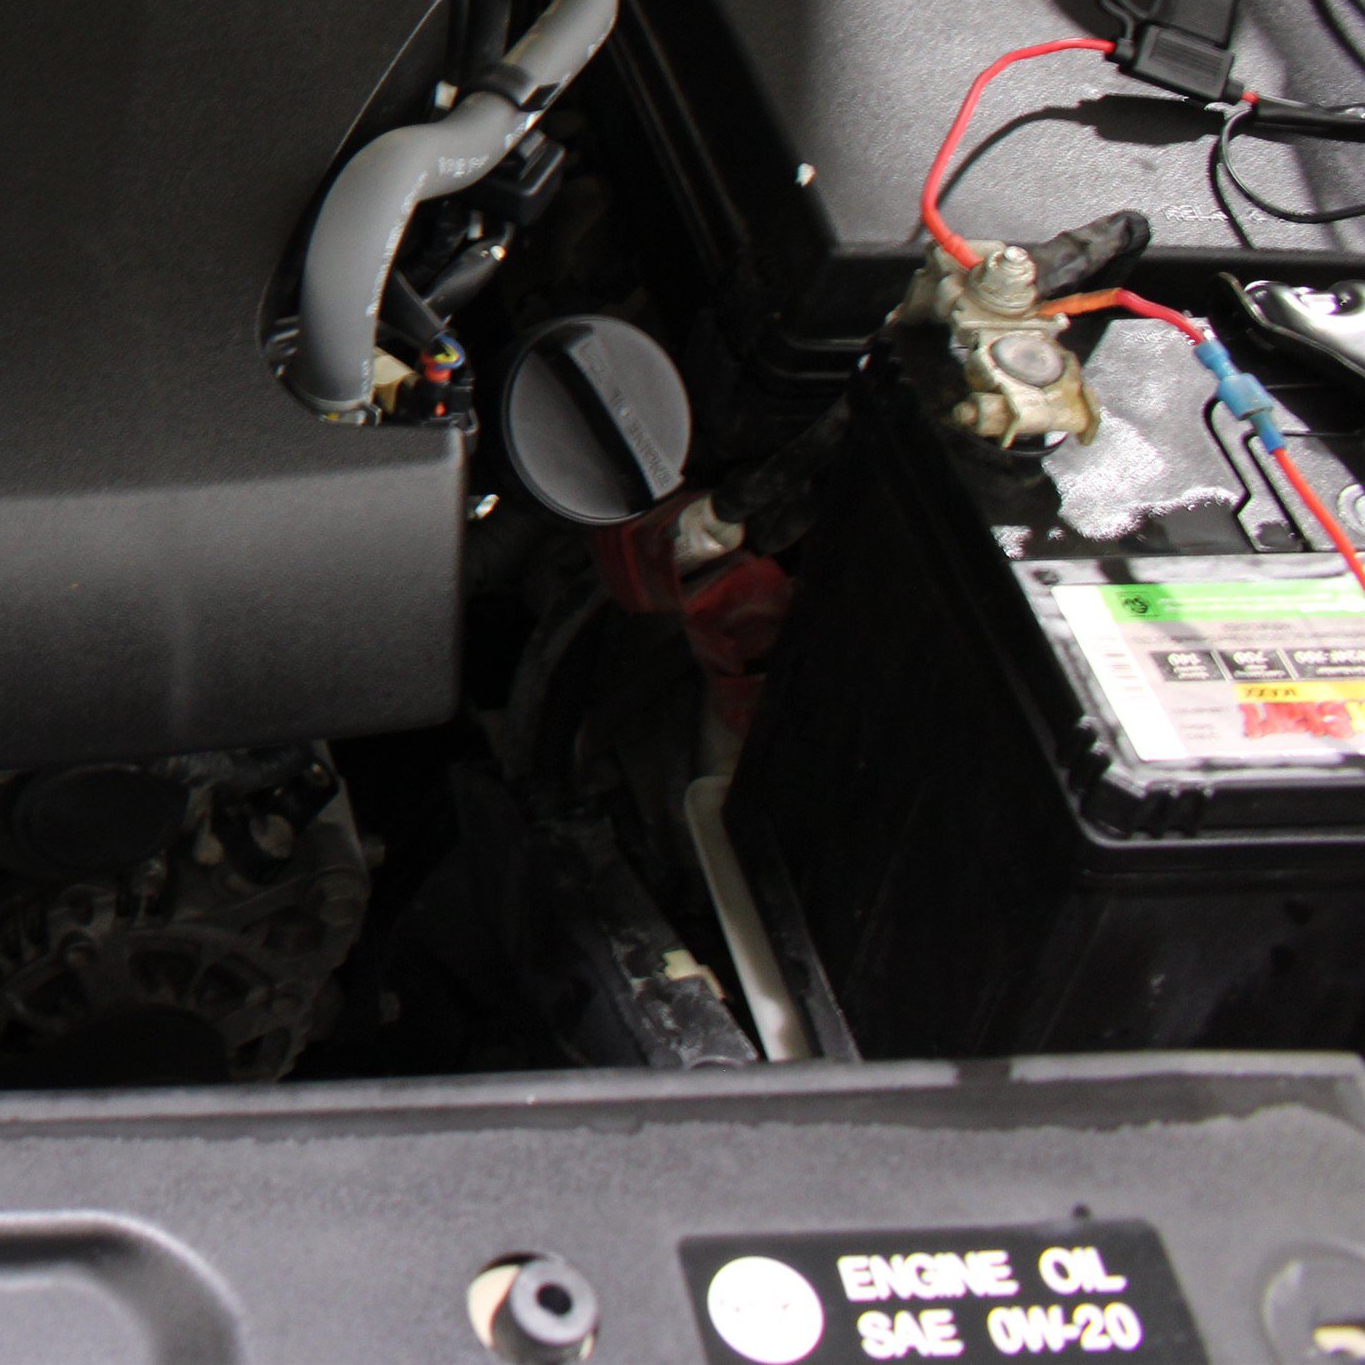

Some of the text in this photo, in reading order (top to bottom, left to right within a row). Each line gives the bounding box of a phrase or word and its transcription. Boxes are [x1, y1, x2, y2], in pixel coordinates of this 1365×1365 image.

[836, 1246, 1128, 1301] ENGINE OIL
[856, 1301, 1143, 1359] SAE 0W-20
